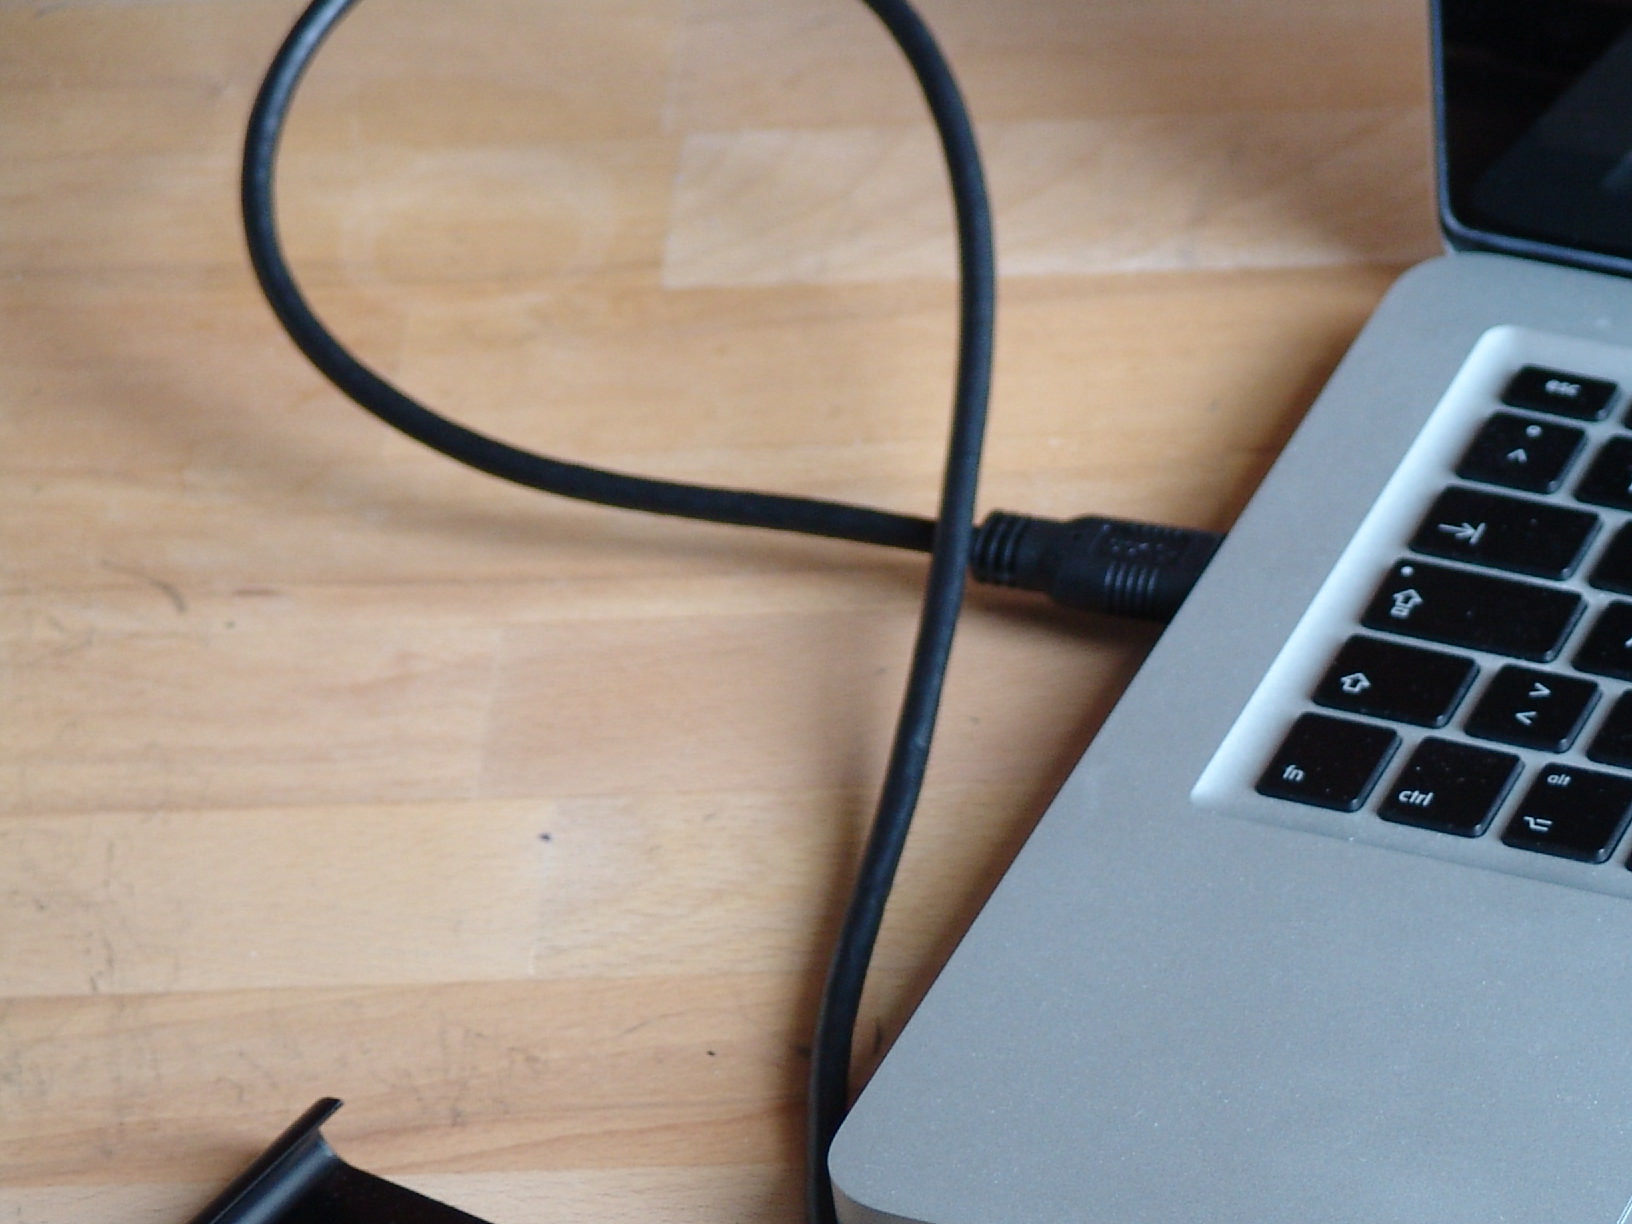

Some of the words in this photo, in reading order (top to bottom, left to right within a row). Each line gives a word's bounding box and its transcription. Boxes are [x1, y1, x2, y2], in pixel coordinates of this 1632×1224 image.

[1282, 763, 1305, 783] fn
[1546, 772, 1573, 787] alt
[1397, 789, 1435, 808] ctrl
